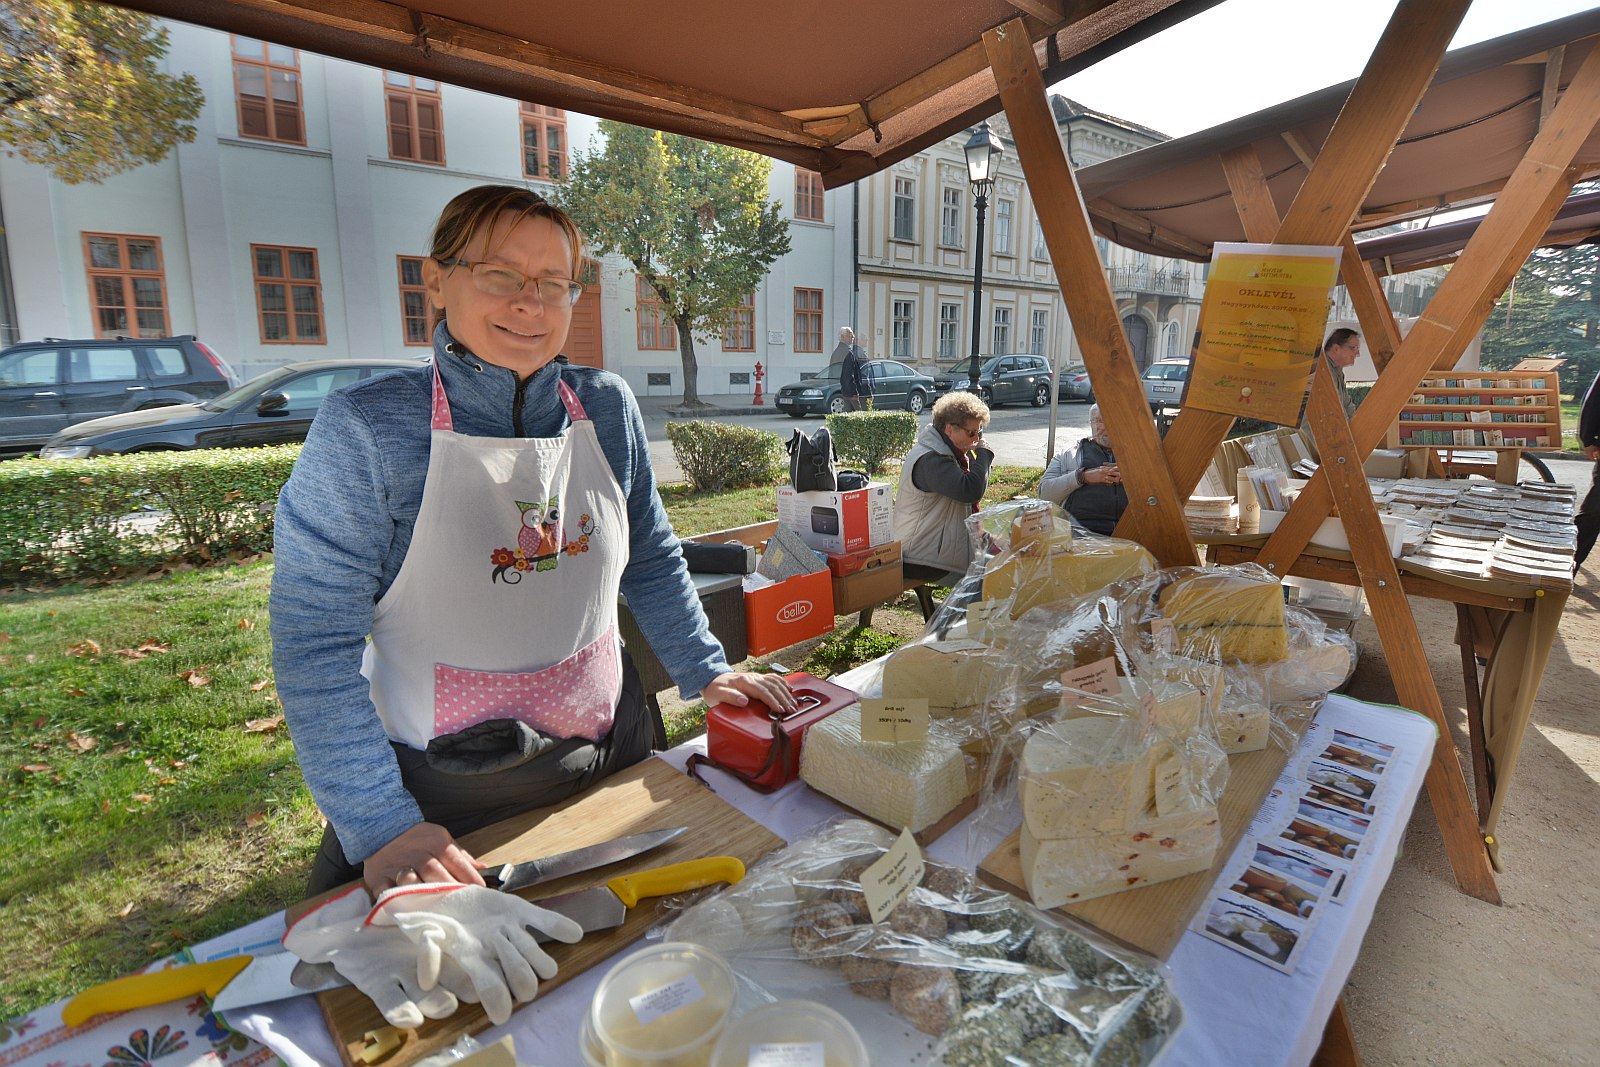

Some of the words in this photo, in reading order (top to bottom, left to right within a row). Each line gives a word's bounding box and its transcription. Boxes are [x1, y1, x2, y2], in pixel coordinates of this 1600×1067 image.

[1238, 287, 1296, 300] OKLEVÉL
[844, 493, 860, 501] Canon
[783, 602, 807, 619] bella
